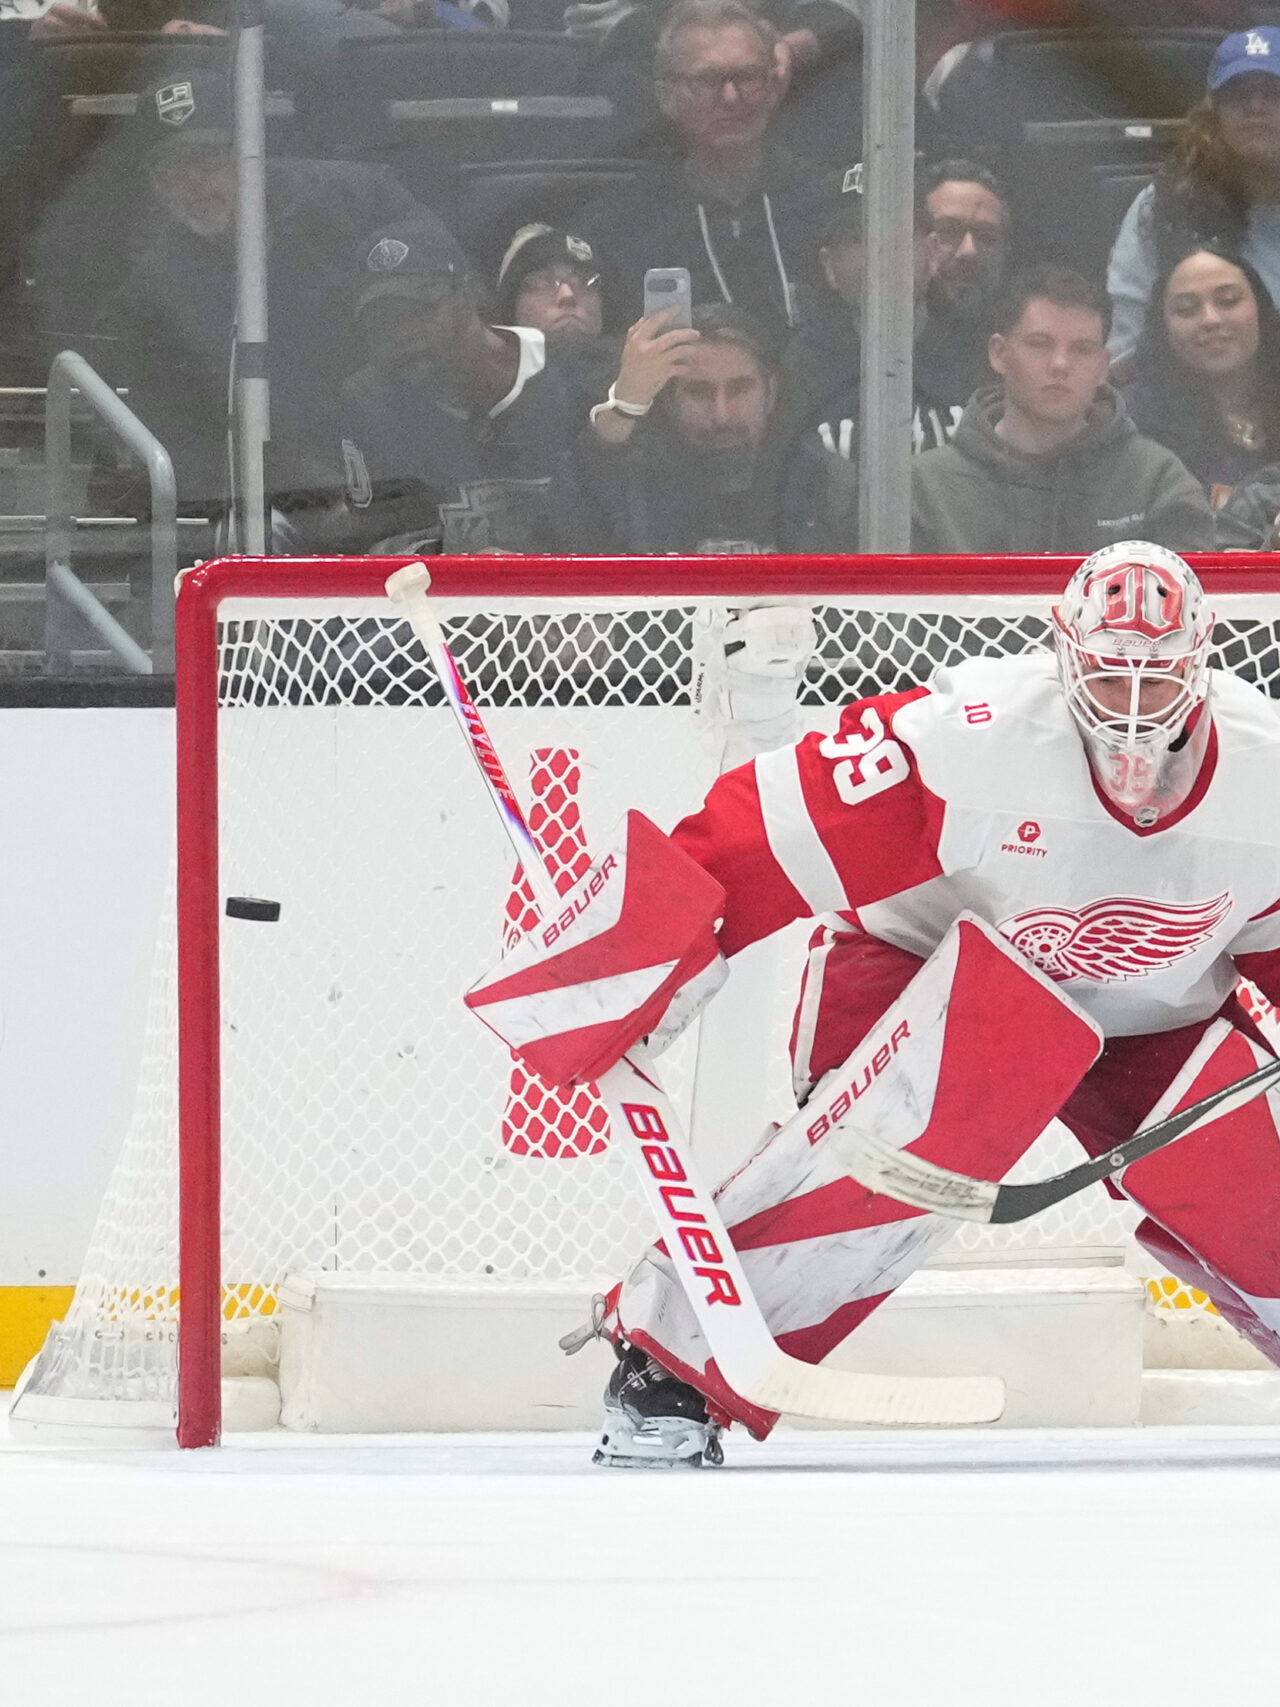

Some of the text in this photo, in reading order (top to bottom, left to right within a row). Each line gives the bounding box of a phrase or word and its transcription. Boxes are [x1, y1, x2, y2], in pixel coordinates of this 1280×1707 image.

[1245, 31, 1270, 55] LA
[159, 85, 189, 105] LA
[461, 700, 514, 800] FLYLITE
[819, 706, 911, 806] 39
[964, 702, 992, 724] 10
[1001, 843, 1048, 859] PRIORITY
[541, 852, 619, 949] BAUER
[806, 1018, 911, 1147] BAUER
[620, 1102, 742, 1307] BAUER
